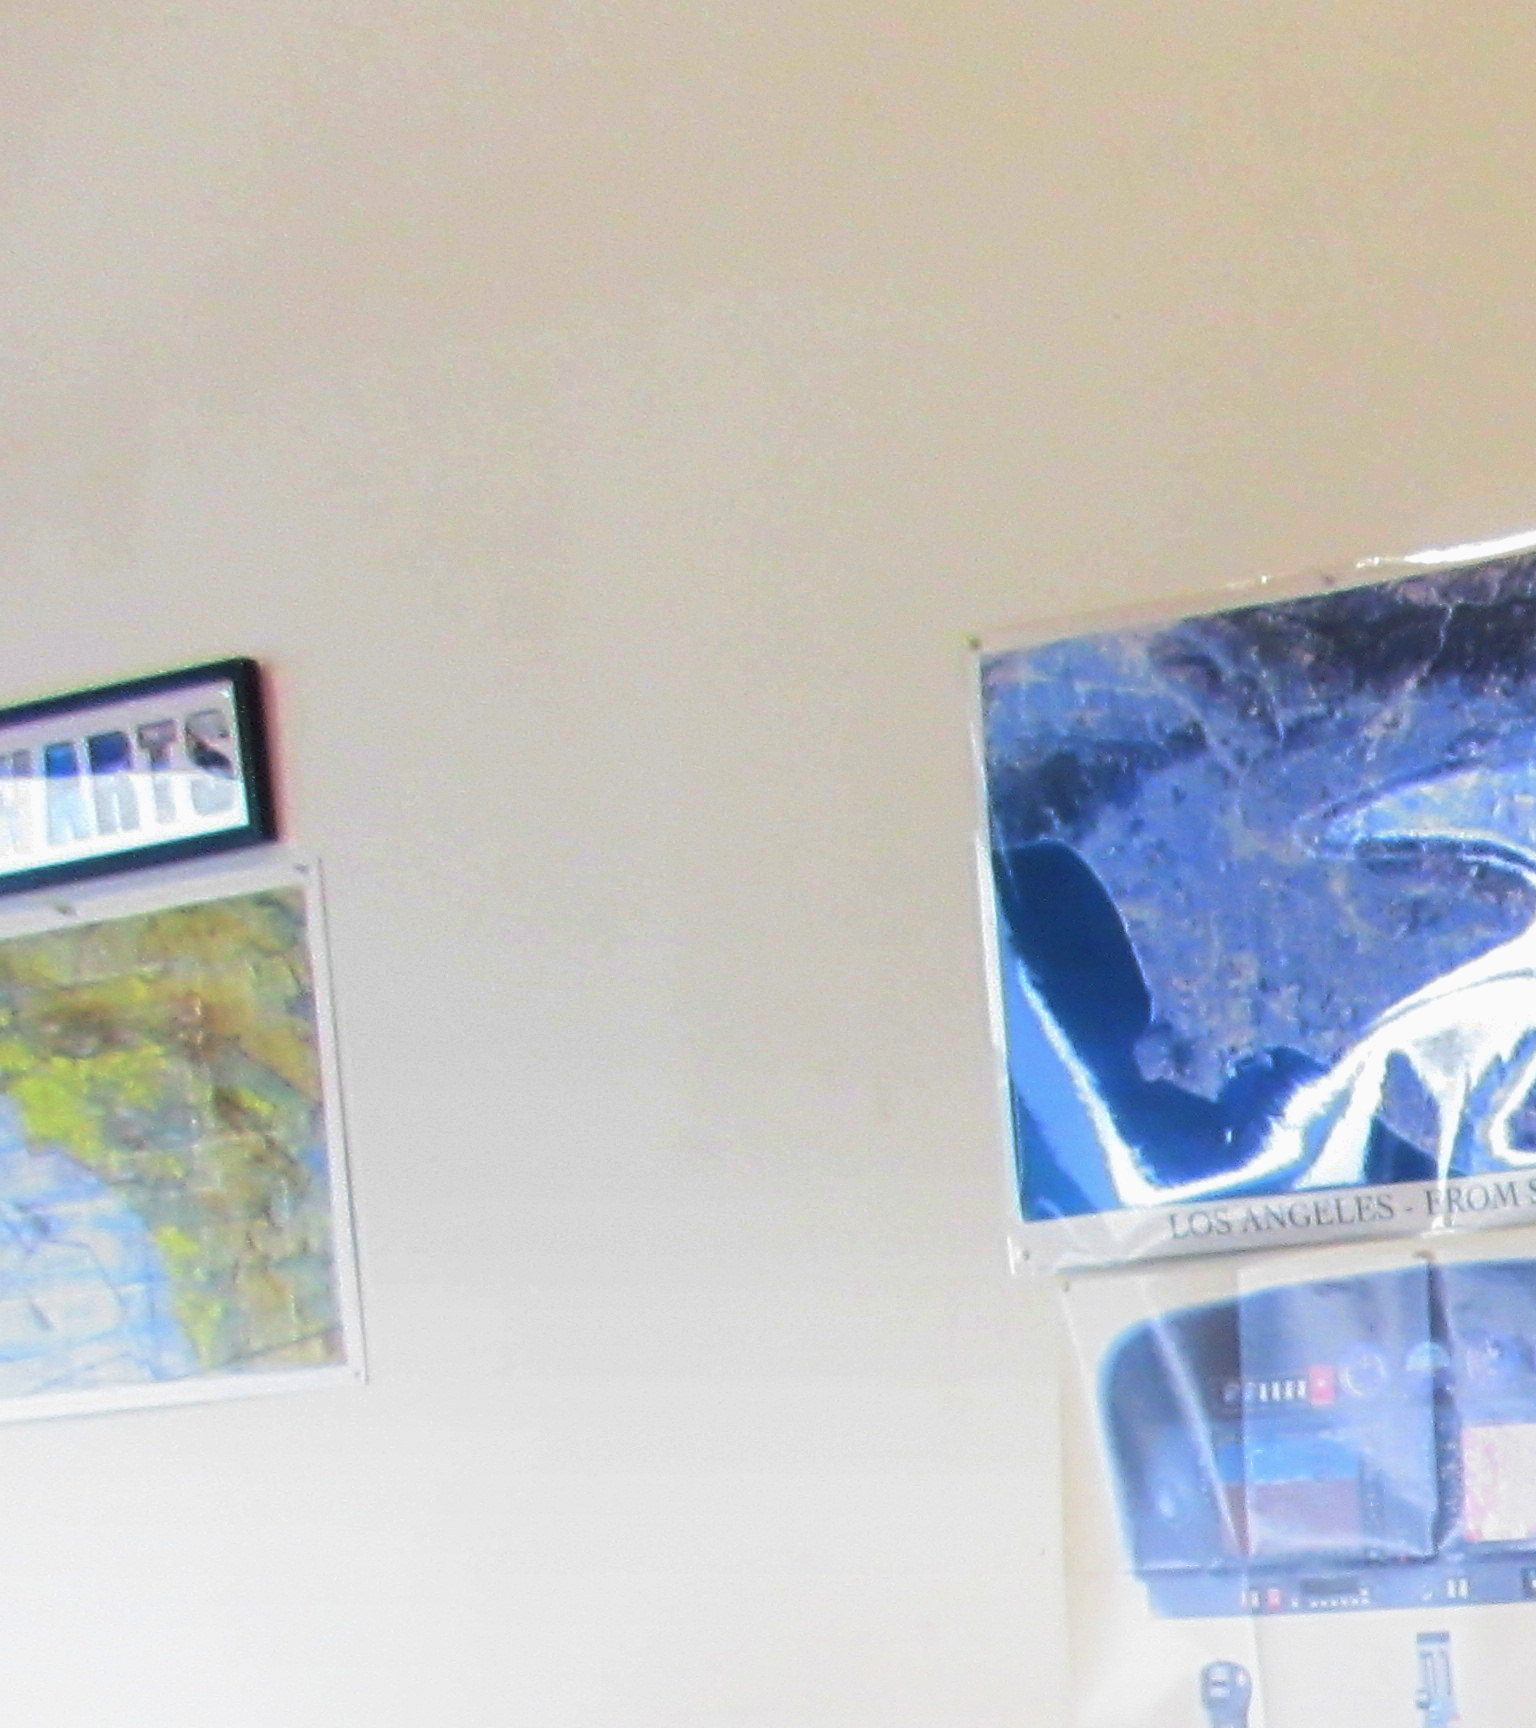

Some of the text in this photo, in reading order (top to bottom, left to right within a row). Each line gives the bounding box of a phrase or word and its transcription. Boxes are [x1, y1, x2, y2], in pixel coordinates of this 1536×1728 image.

[1169, 1211, 1232, 1239] LOS
[1242, 1194, 1396, 1233] ANGELES
[1425, 1181, 1520, 1217] FROM
